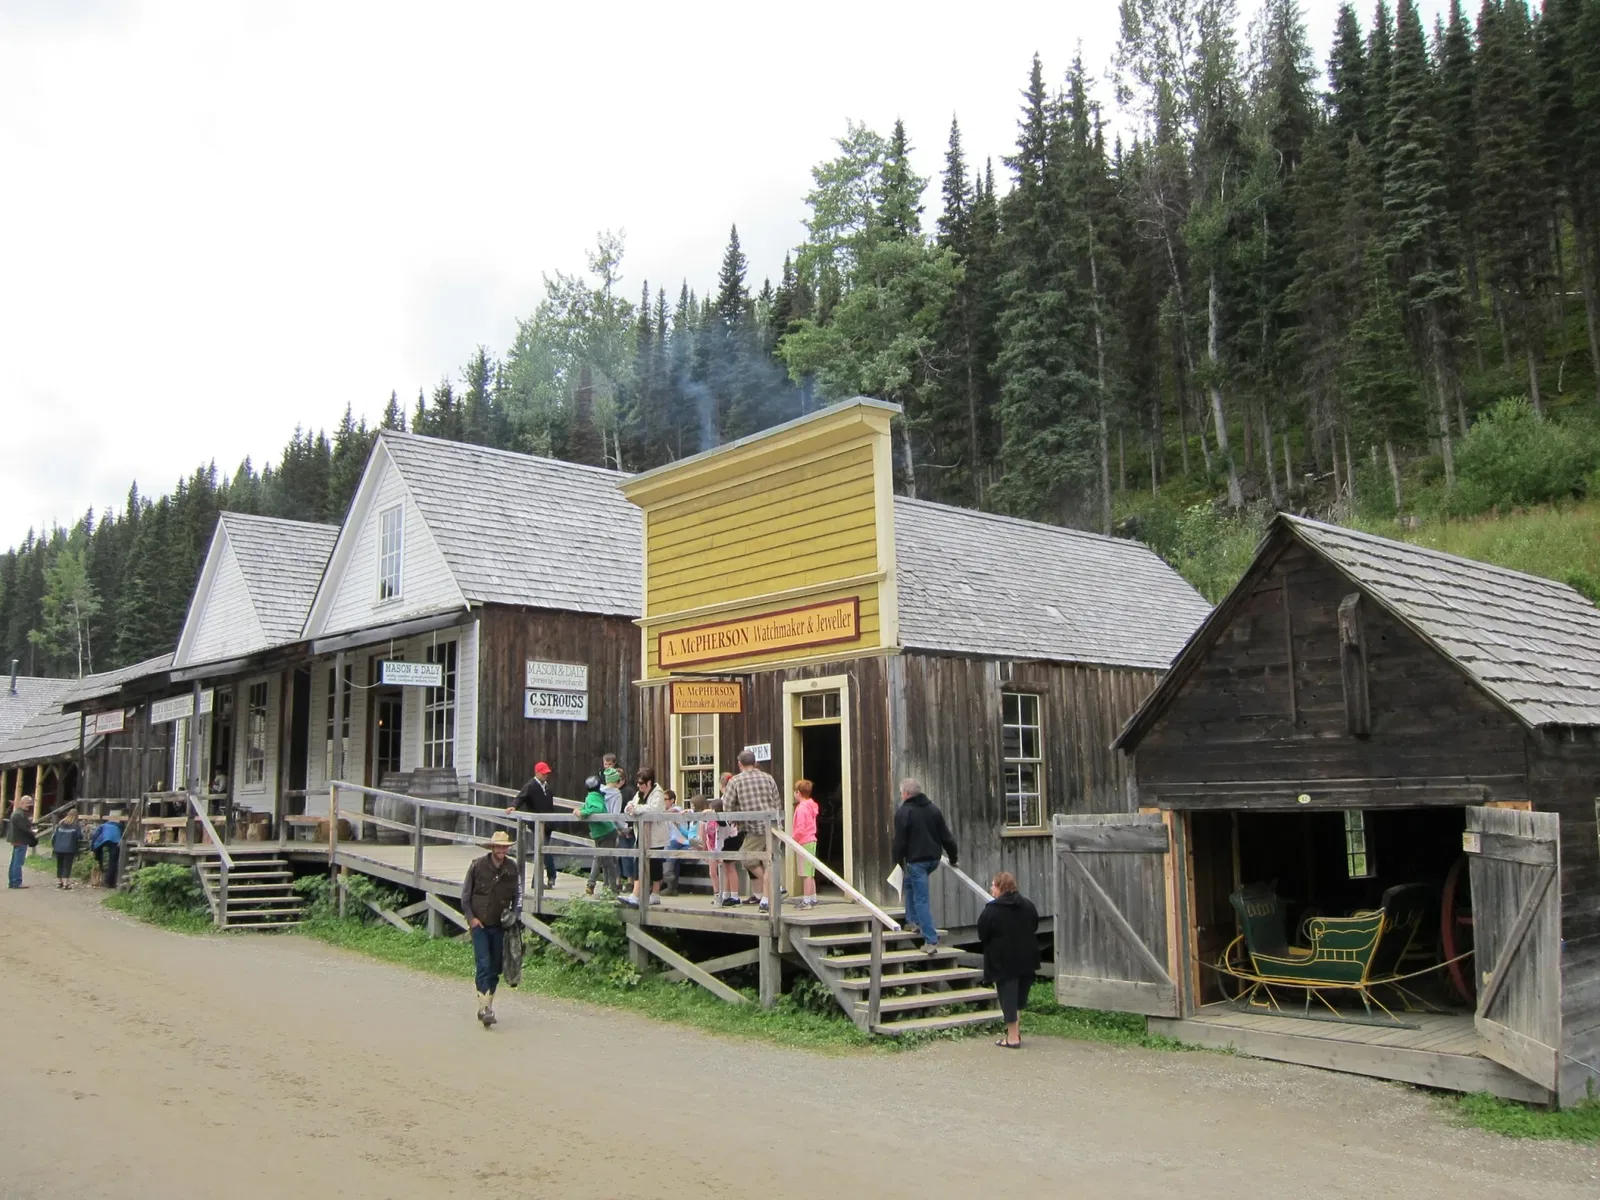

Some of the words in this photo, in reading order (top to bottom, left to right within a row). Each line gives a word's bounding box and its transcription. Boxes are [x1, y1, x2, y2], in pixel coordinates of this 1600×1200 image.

[666, 641, 677, 657] A.
[680, 627, 749, 655] McPHERSON
[753, 617, 805, 642] Watchmaker
[806, 616, 814, 634] &
[816, 609, 852, 632] Jeweller
[385, 663, 412, 673] MASON
[414, 665, 419, 674] &
[421, 666, 441, 675] DALY
[528, 663, 557, 676] MASON
[557, 665, 565, 676] &
[565, 666, 586, 678] DALY
[687, 686, 735, 696] McPHERSON
[540, 692, 584, 708] STROUSS
[675, 697, 710, 708] Watchmaker
[711, 699, 716, 708] &
[716, 698, 738, 708] Jeweller
[687, 771, 714, 783] WATCHE
